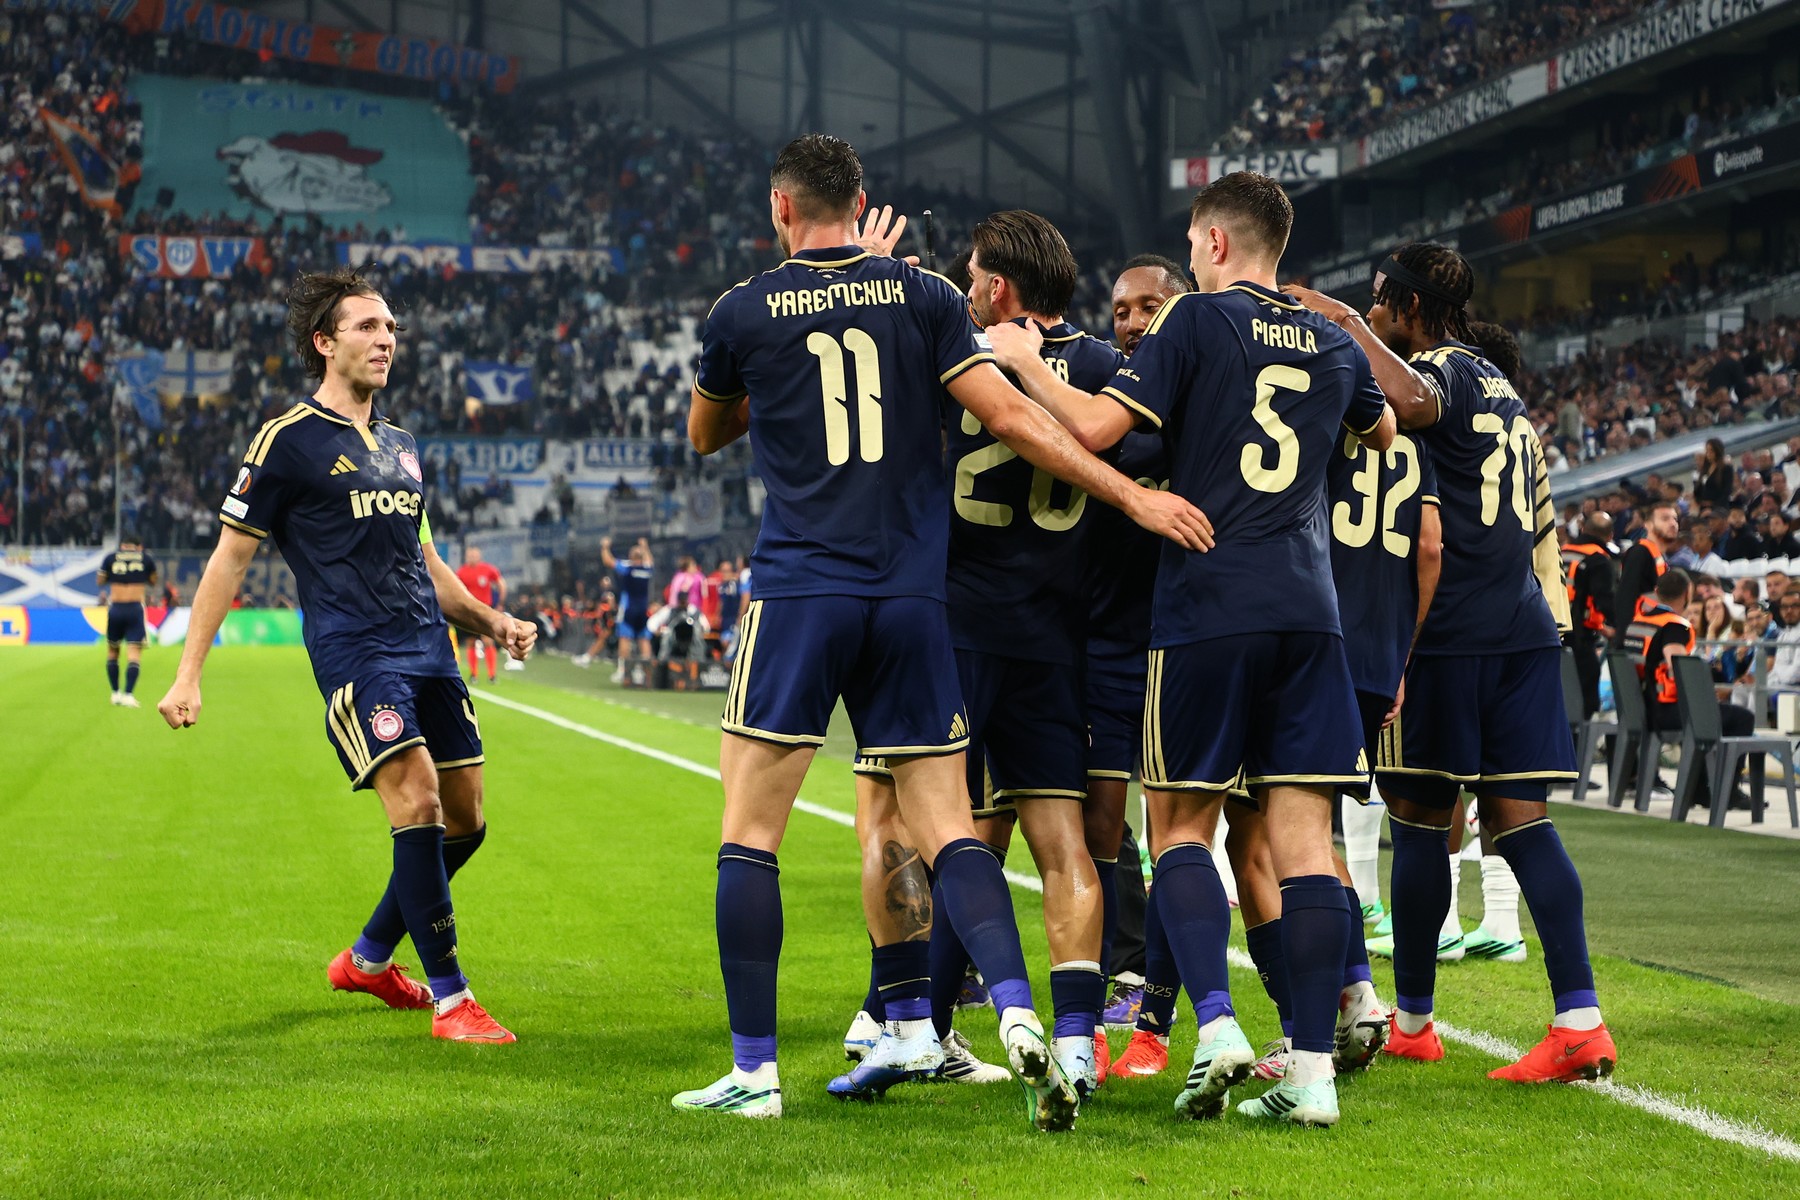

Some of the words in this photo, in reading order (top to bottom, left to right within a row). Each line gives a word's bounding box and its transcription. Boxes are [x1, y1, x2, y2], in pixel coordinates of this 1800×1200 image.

[161, 0, 313, 60] KAOTIC
[376, 36, 509, 90] GROUP
[1220, 150, 1321, 178] CEPAC
[766, 279, 905, 318] YAREMCHUK
[1251, 317, 1319, 354] PIROLA
[806, 327, 884, 466] 11
[1239, 364, 1311, 494] 5
[1332, 434, 1421, 559] 32
[1472, 412, 1534, 533] 70
[1143, 981, 1174, 998] 1925
